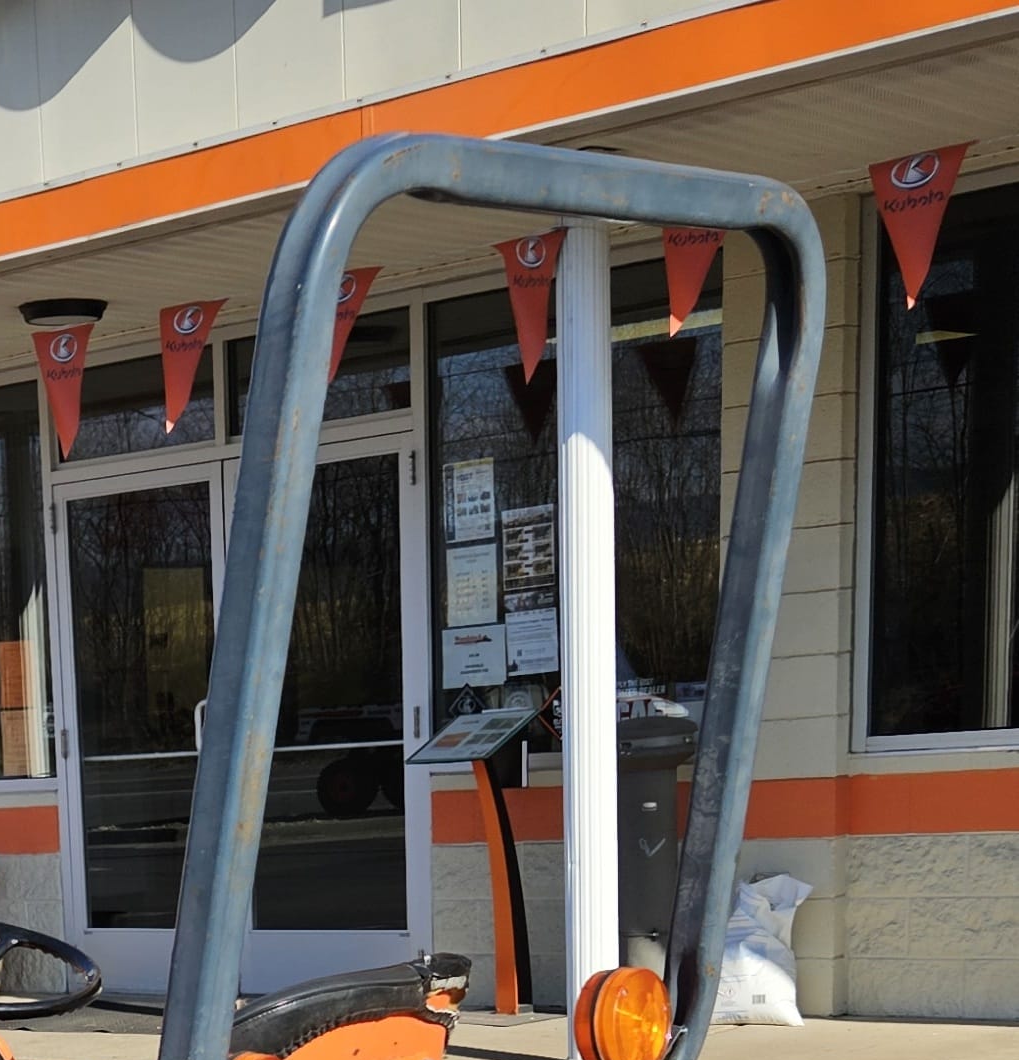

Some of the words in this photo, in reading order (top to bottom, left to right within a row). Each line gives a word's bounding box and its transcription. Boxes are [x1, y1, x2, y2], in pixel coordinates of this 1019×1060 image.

[884, 190, 944, 212] Kubota
[668, 231, 719, 246] Kubota
[165, 339, 204, 352] Kubota
[46, 367, 82, 380] Kubota
